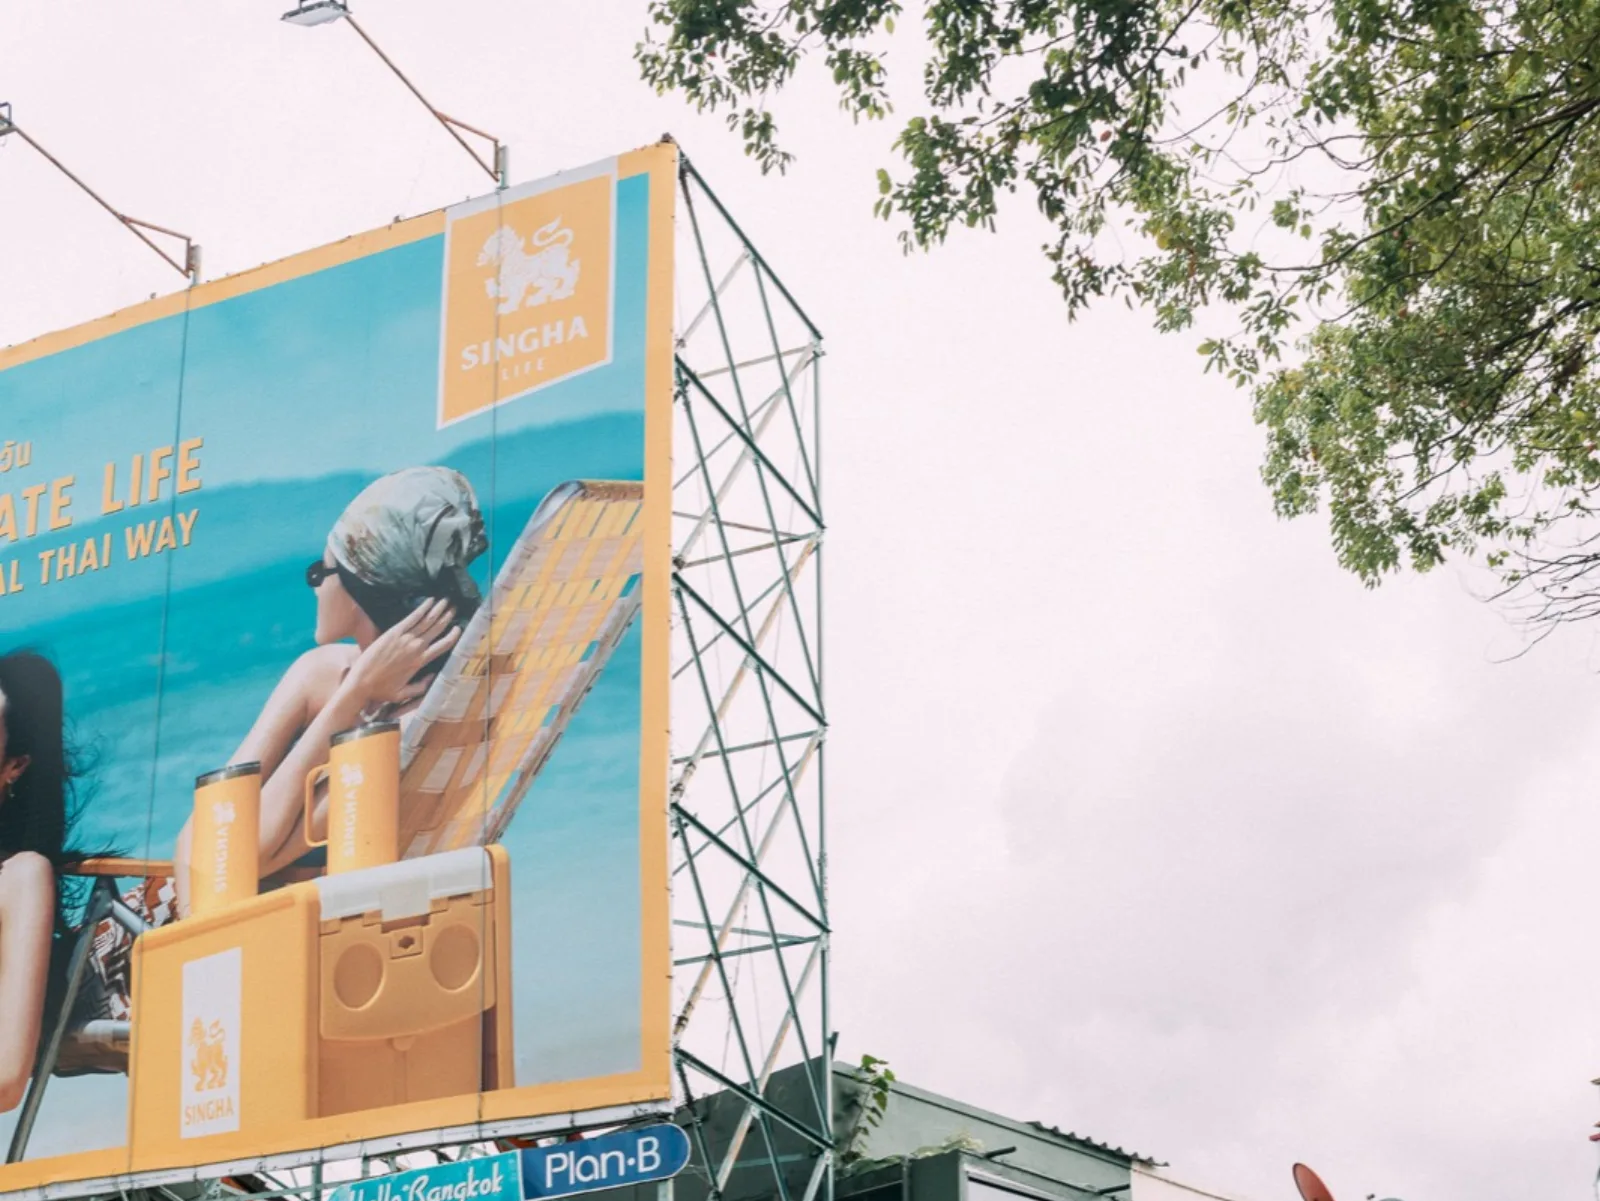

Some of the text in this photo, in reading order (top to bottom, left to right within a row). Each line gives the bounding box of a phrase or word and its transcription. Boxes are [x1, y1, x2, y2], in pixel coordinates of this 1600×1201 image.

[461, 315, 589, 372] SINGHA
[501, 357, 545, 381] LIFE
[102, 436, 204, 516] LIFE
[38, 533, 112, 585] THAI
[124, 508, 200, 561] WAY
[184, 1095, 235, 1126] SINGHA
